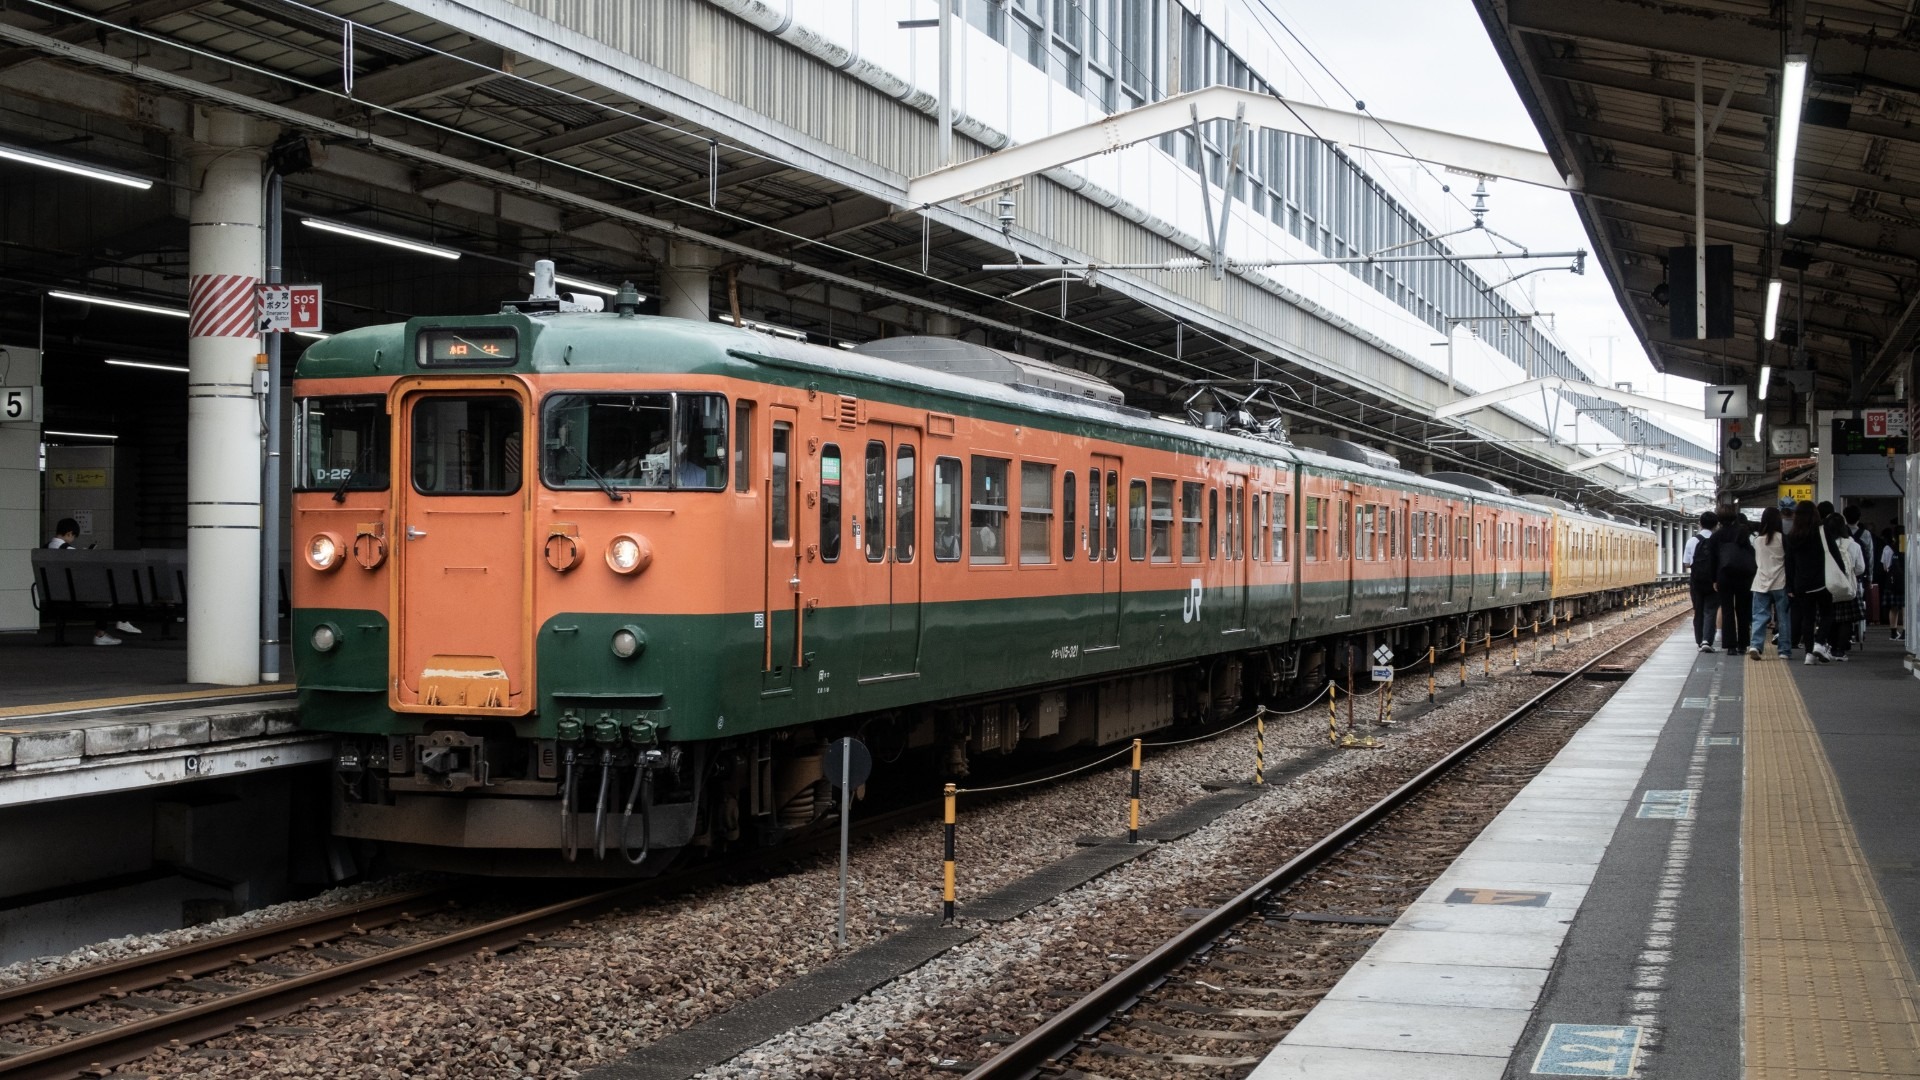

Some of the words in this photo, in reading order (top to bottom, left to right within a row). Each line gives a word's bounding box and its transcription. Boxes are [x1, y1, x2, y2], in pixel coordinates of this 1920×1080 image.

[266, 292, 289, 300] 非常
[293, 295, 315, 304] SOS
[7, 391, 22, 418] 5
[1717, 390, 1734, 414] 7
[1184, 578, 1202, 623] JR
